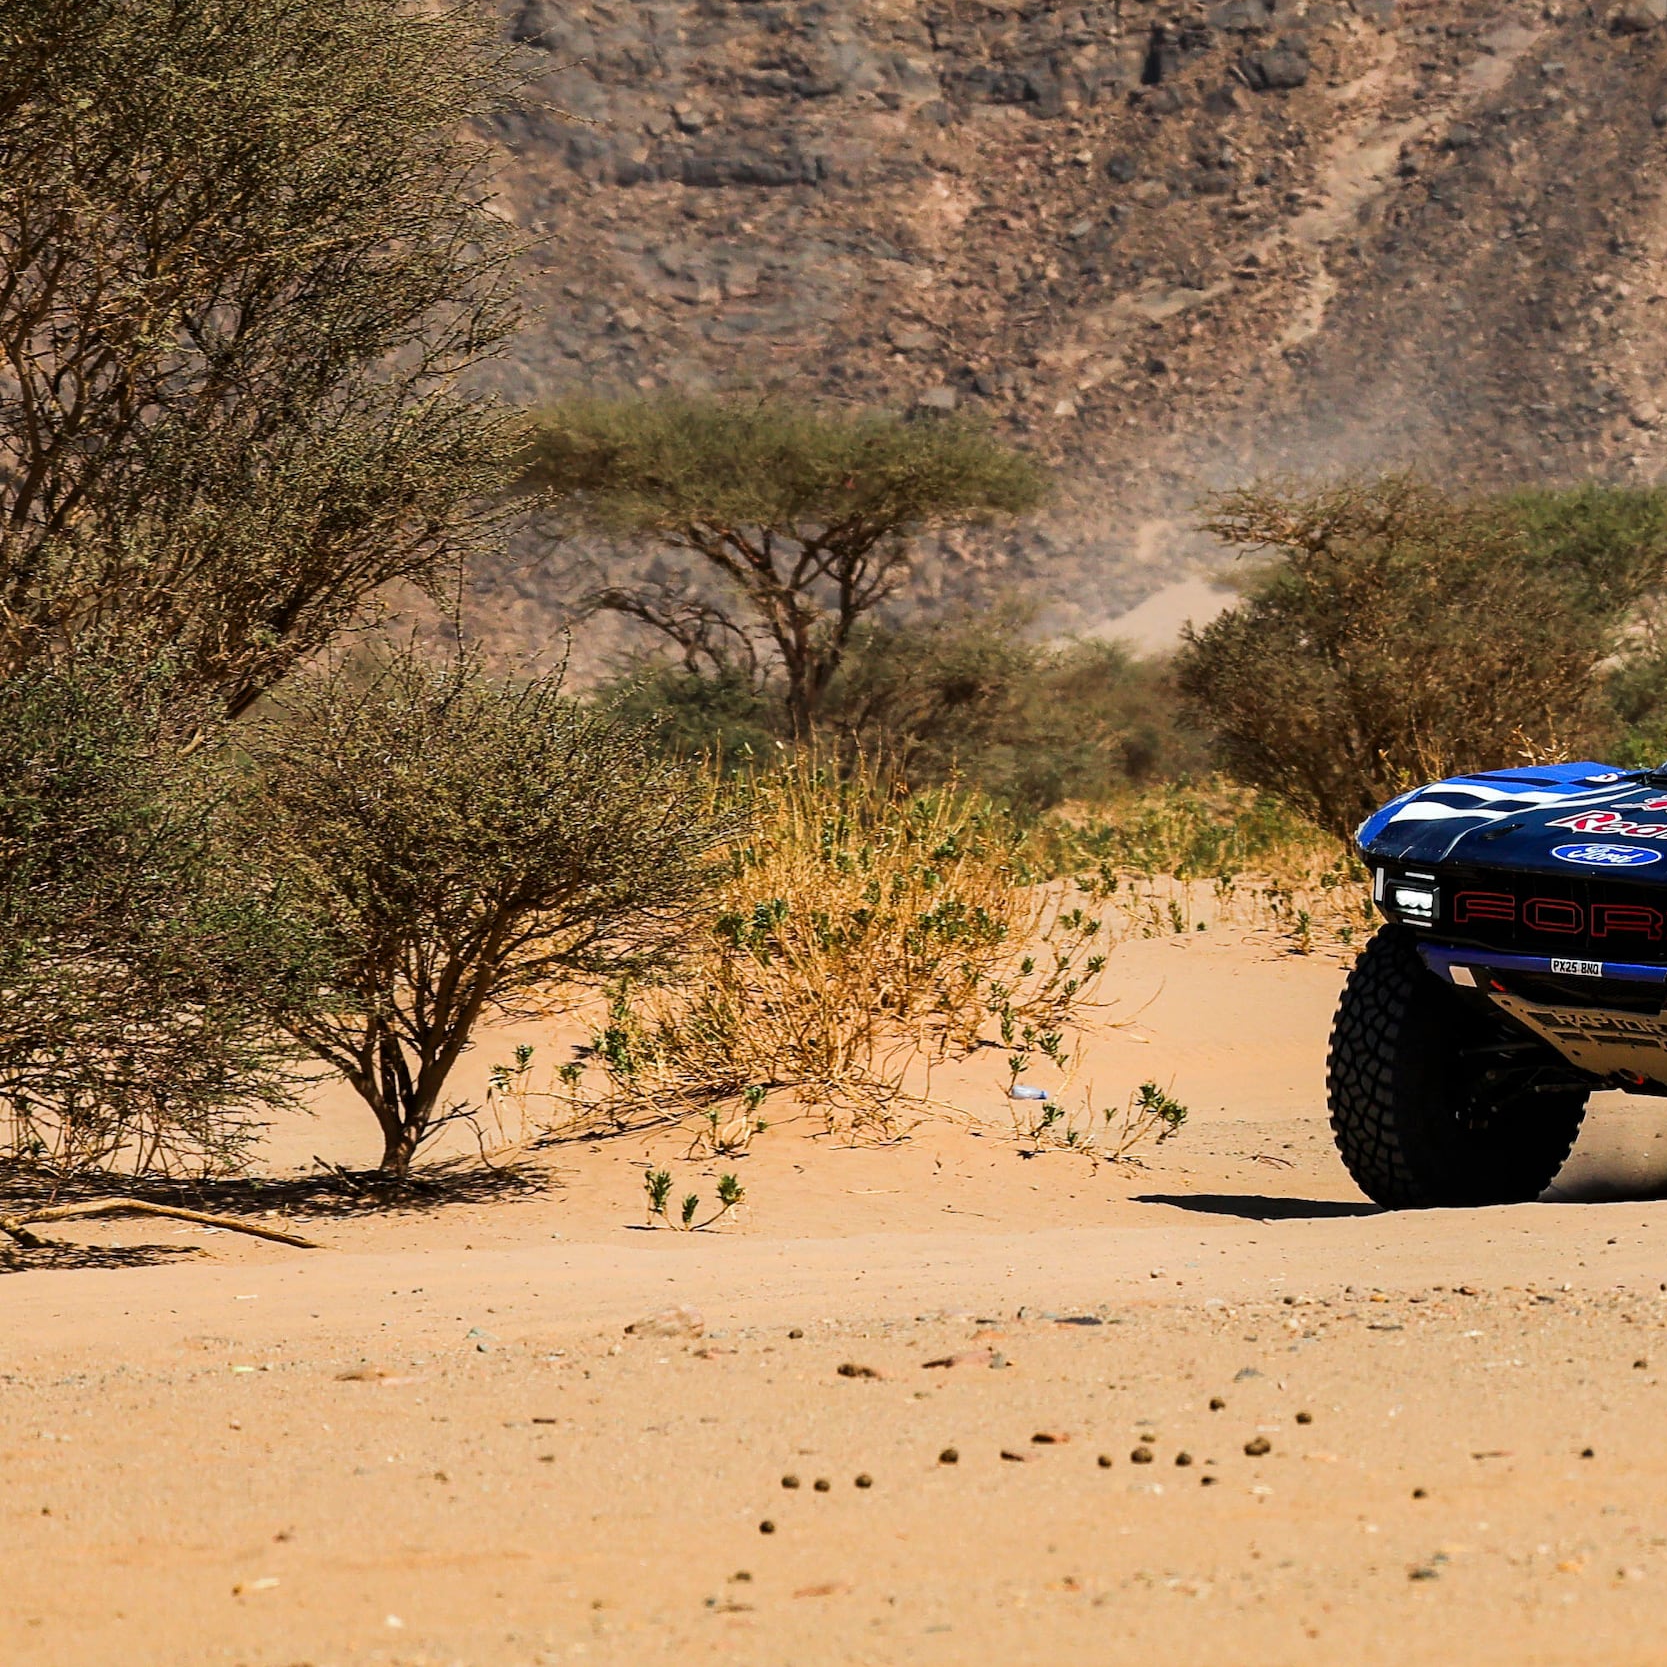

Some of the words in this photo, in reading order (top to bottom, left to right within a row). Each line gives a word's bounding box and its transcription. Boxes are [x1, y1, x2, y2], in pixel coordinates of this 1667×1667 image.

[1565, 844, 1644, 864] Ford
[1553, 960, 1577, 973] PX25
[1555, 1011, 1667, 1035] RAPTOR
